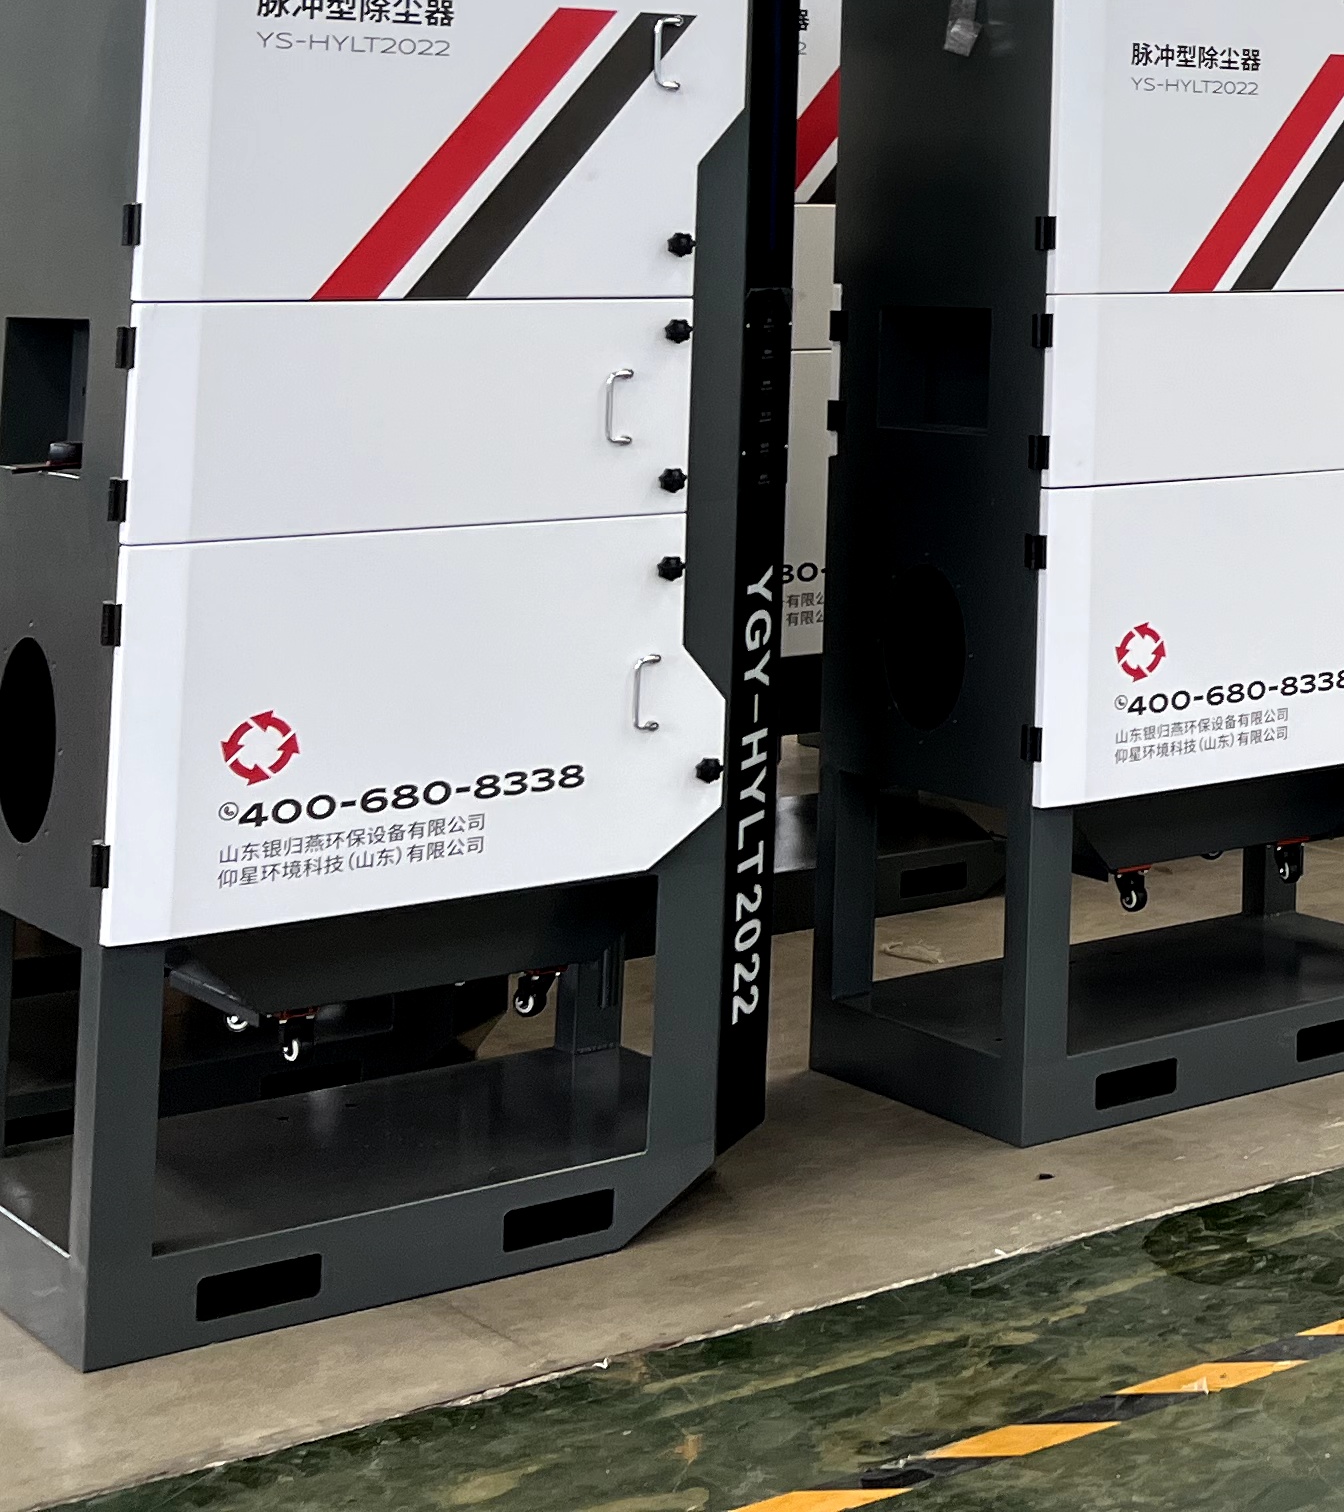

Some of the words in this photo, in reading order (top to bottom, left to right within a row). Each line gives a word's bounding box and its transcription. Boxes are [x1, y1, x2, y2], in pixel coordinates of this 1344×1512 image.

[256, 31, 451, 57] YS-HYLT2022
[1131, 42, 1262, 73] 脉冲型除尘器
[1131, 77, 1259, 96] YS-HYLT2022
[1114, 707, 1289, 745] 山东银归燕环保设备有限公司
[237, 764, 585, 828] 400-680-8338
[732, 565, 774, 1025] YGY-HYLT2022
[219, 813, 486, 864] 山东银归燕环保设备有限公司
